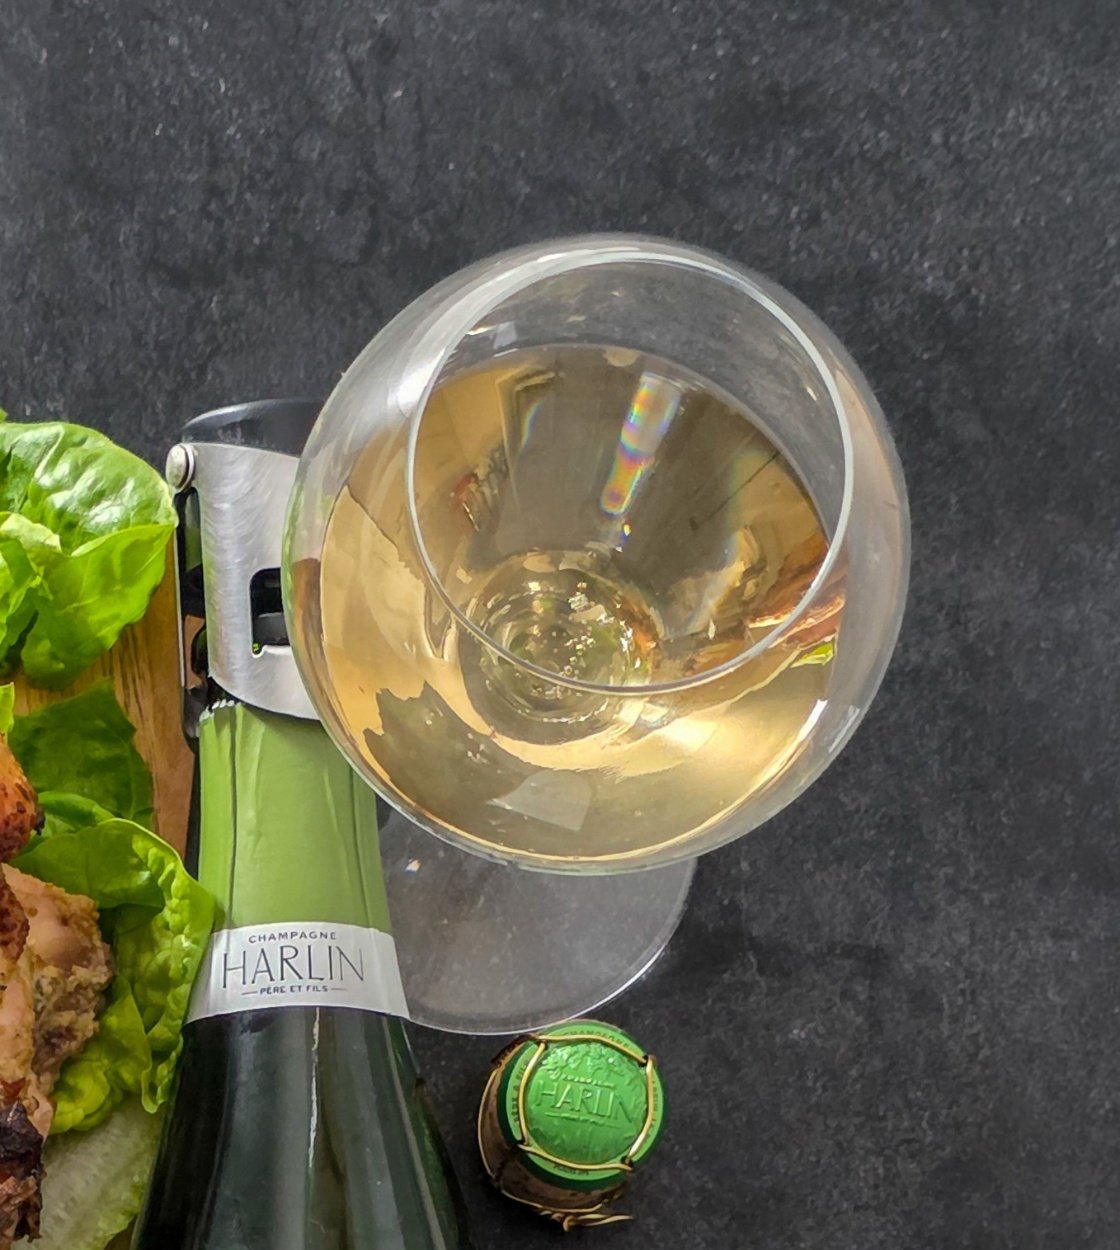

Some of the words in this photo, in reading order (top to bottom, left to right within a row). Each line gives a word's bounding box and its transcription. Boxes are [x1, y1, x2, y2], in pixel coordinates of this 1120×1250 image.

[248, 931, 337, 943] CHAMPAGNE
[222, 945, 364, 988] HARLIN
[290, 985, 303, 993] ET
[306, 984, 329, 993] FILS
